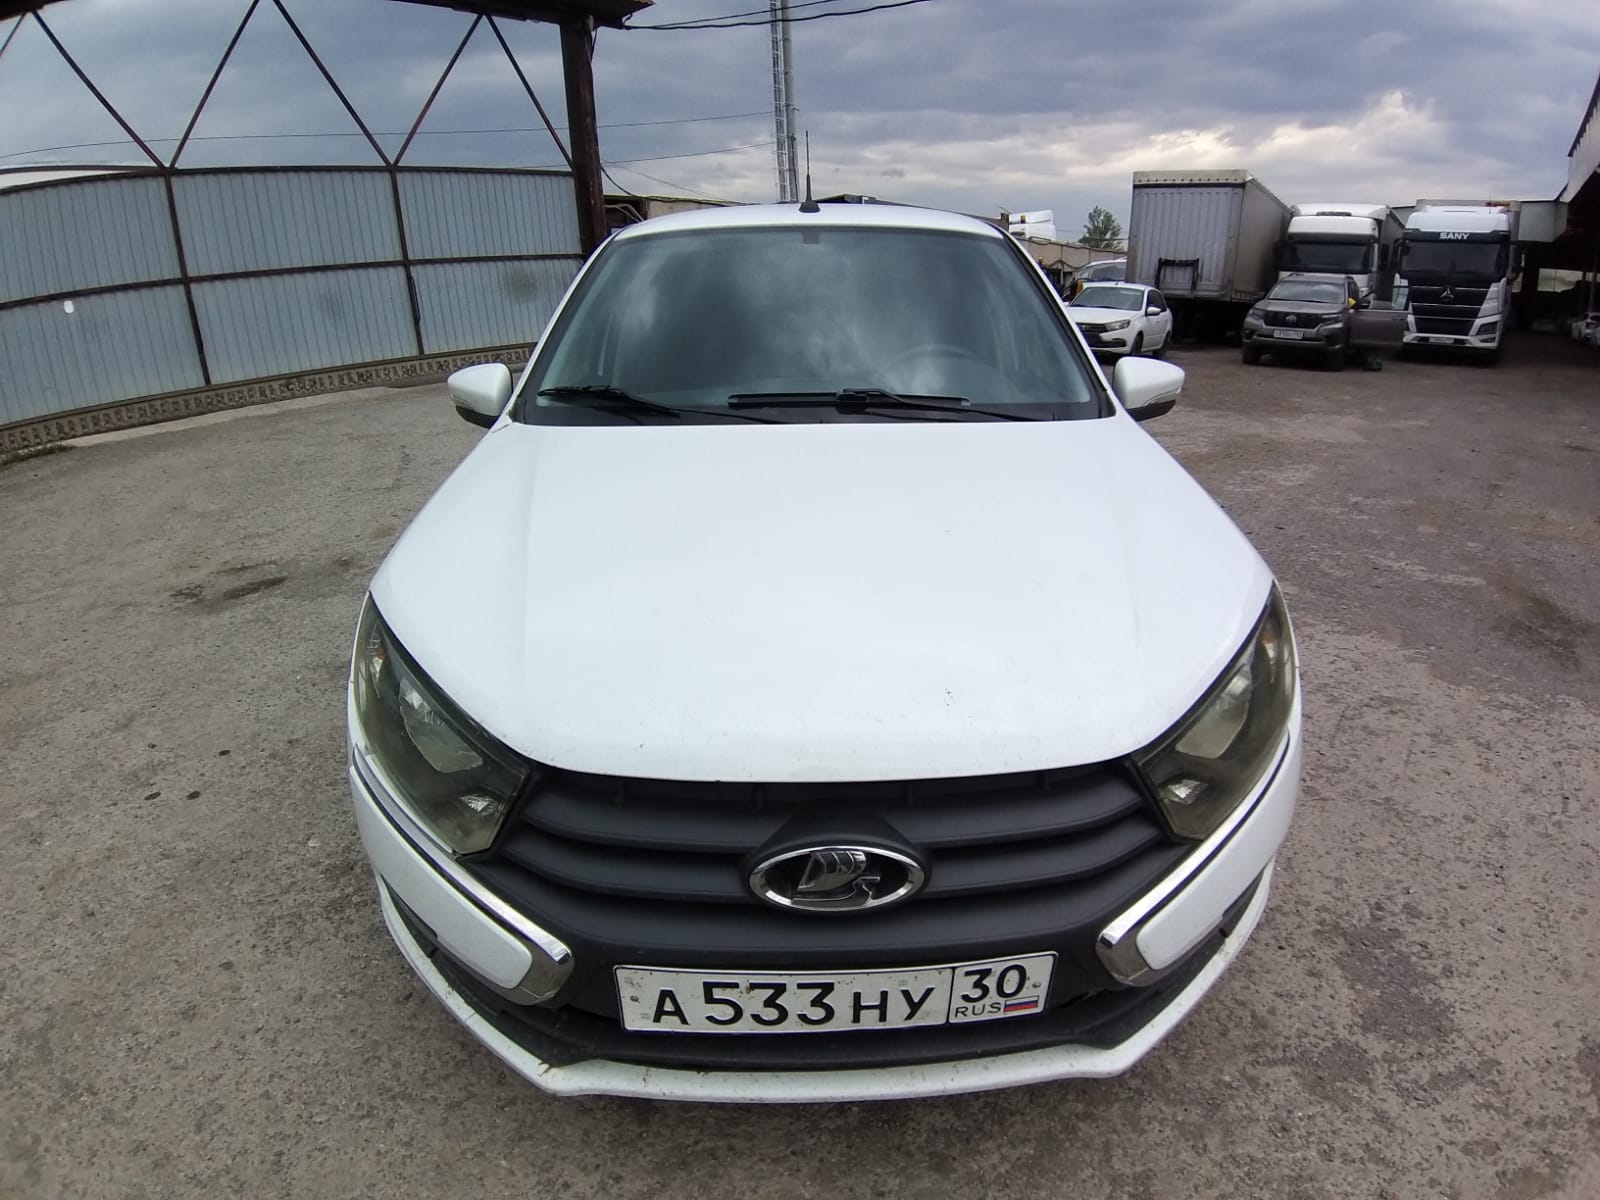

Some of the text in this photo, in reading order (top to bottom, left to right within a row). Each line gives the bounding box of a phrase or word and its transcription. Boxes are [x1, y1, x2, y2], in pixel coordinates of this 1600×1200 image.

[1439, 232, 1470, 240] SANY
[960, 964, 1027, 1003] 30
[955, 1002, 1002, 1018] RUS
